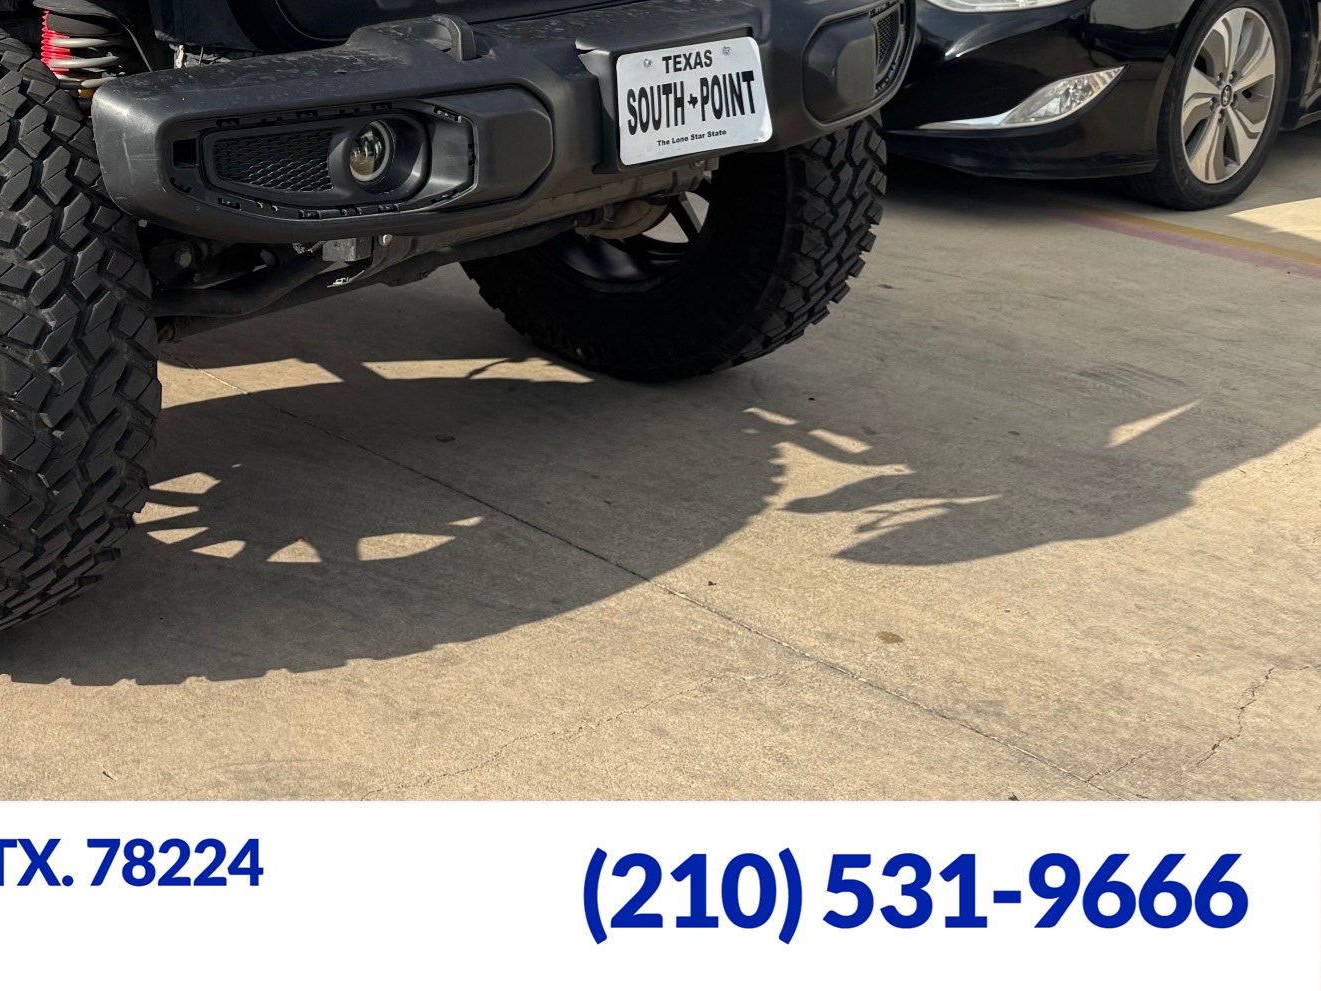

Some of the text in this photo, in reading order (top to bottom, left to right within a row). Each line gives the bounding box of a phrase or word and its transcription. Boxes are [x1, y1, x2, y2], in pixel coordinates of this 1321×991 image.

[661, 49, 713, 74] TEXAS
[626, 70, 755, 136] SOUTH POINT
[657, 129, 727, 147] The Lone Star State
